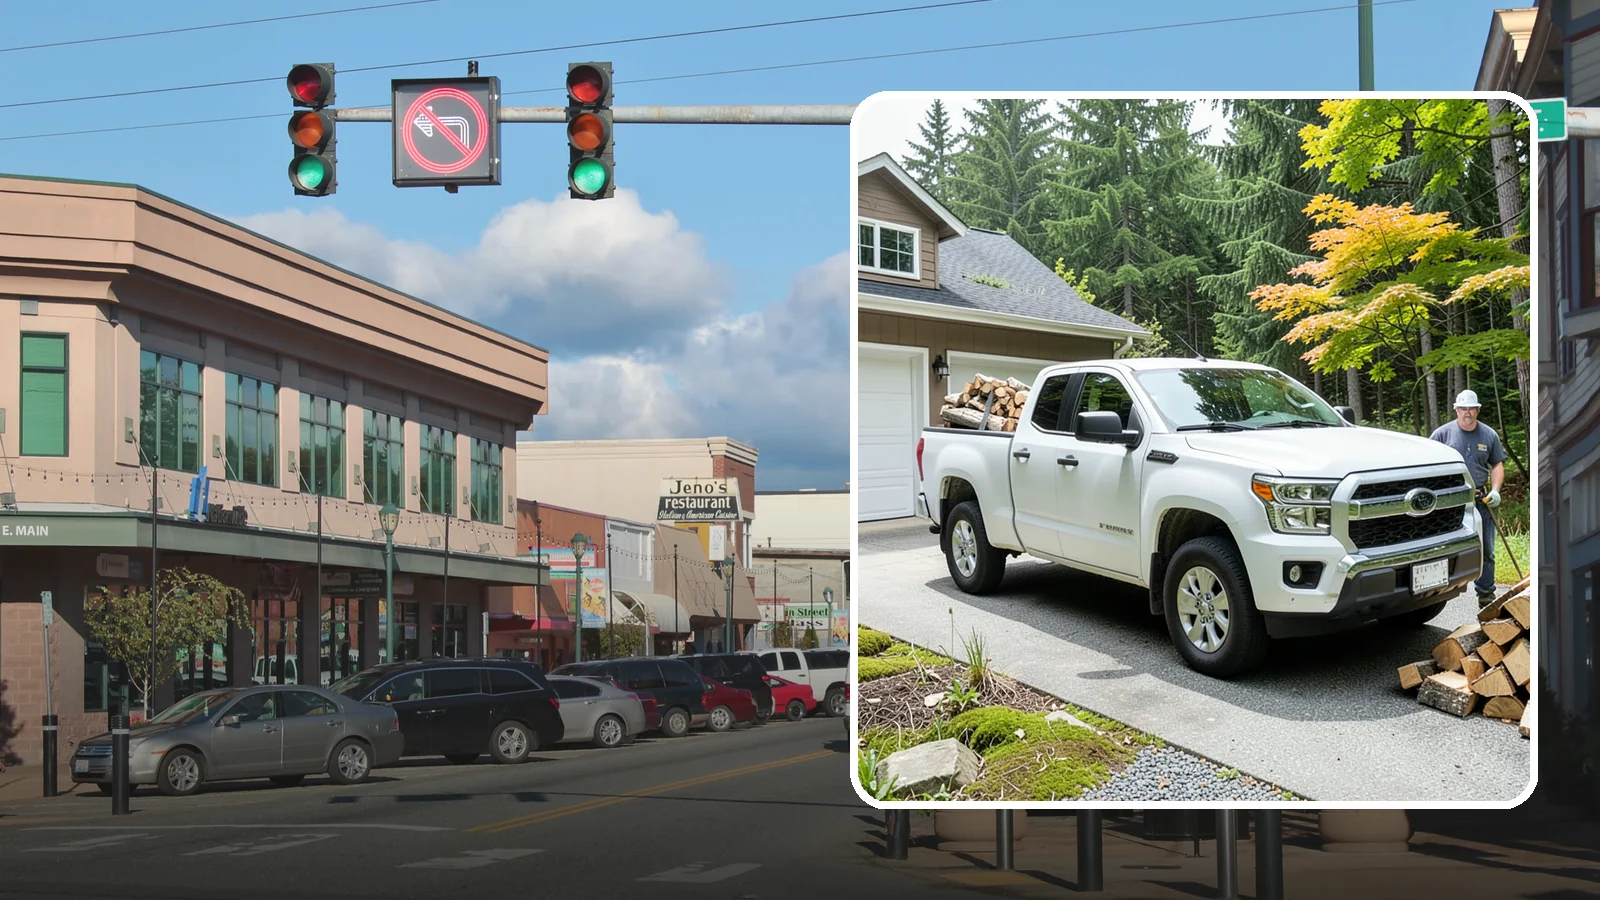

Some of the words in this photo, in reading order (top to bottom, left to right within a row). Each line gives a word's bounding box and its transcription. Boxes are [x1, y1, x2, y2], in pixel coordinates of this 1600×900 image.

[669, 480, 728, 494] Jeno's
[665, 496, 731, 509] restaurant
[659, 510, 682, 520] Italian
[686, 509, 715, 519] American
[715, 509, 737, 519] Cuisine
[2, 525, 13, 536] E.
[15, 525, 49, 536] MAIN
[785, 607, 795, 617] in
[797, 607, 828, 617] Street
[791, 619, 824, 627] lass
